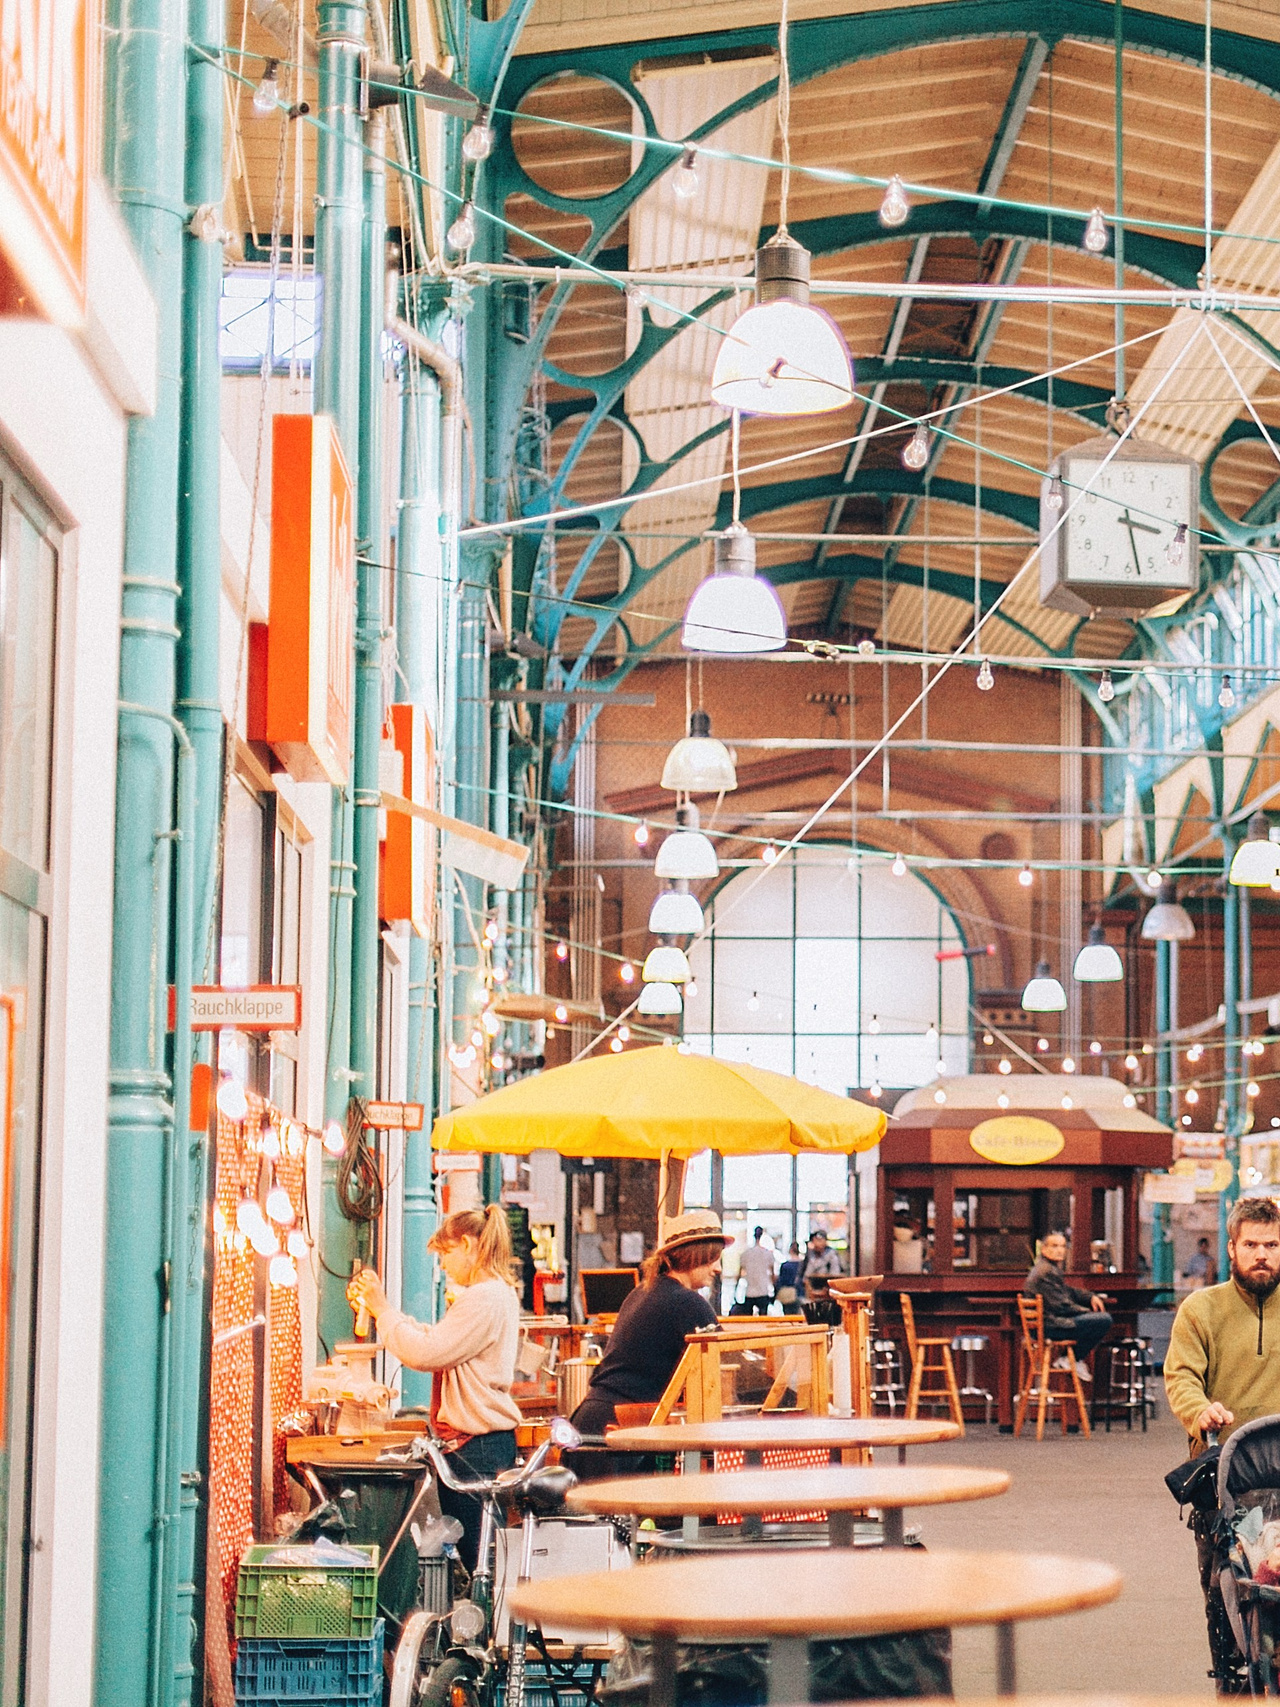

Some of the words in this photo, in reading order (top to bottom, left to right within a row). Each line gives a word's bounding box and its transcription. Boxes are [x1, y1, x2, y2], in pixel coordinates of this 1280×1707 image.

[1101, 477, 1111, 488] 11
[1122, 471, 1135, 484] 12
[1165, 496, 1173, 509] 2
[1078, 514, 1086, 527] 9
[1084, 538, 1092, 551] 8
[1103, 555, 1109, 568] 7
[1124, 562, 1132, 574] 6
[1147, 556, 1155, 569] 5
[191, 998, 283, 1019] Rauchklappe
